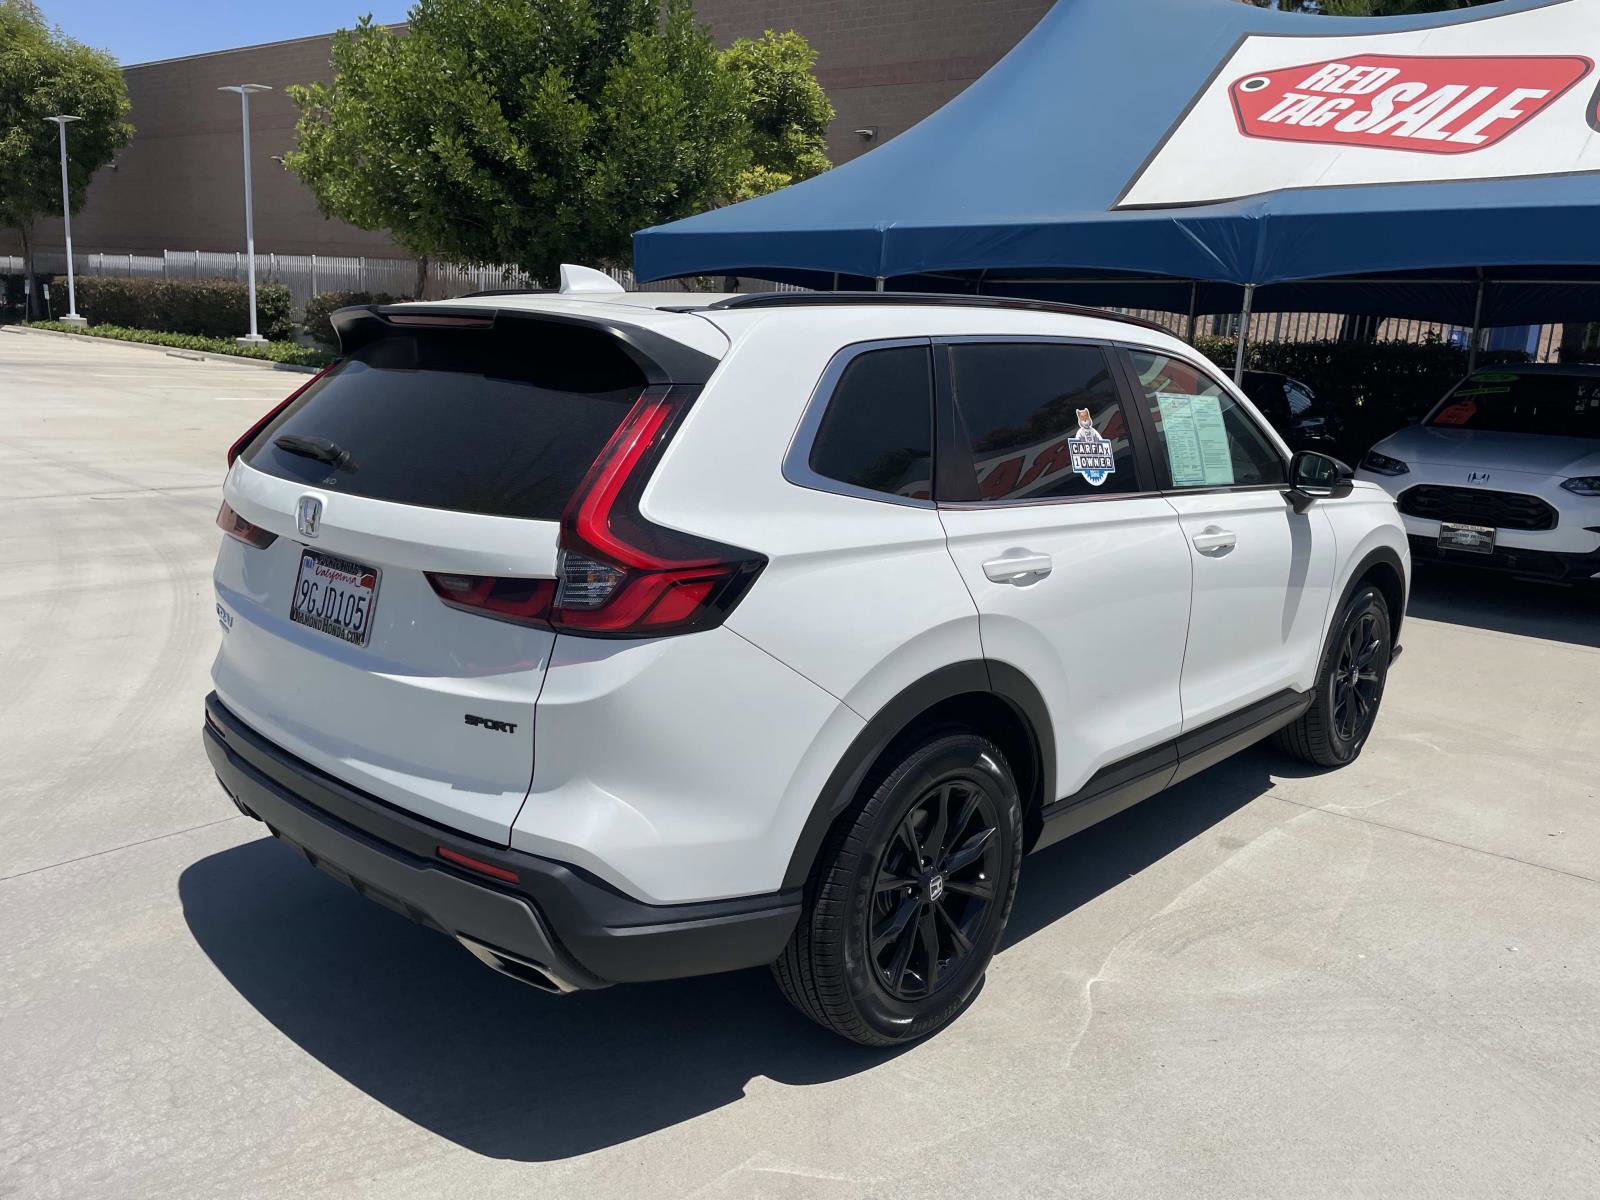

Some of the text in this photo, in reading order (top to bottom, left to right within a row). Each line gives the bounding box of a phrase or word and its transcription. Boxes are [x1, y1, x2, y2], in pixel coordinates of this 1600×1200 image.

[1295, 63, 1400, 95] RED
[1257, 92, 1355, 128] TAG
[1333, 81, 1552, 145] SALE
[1072, 443, 1110, 456] CARFAX
[315, 565, 357, 586] California
[298, 579, 366, 632] 9GJD105
[464, 714, 518, 734] SPORT
